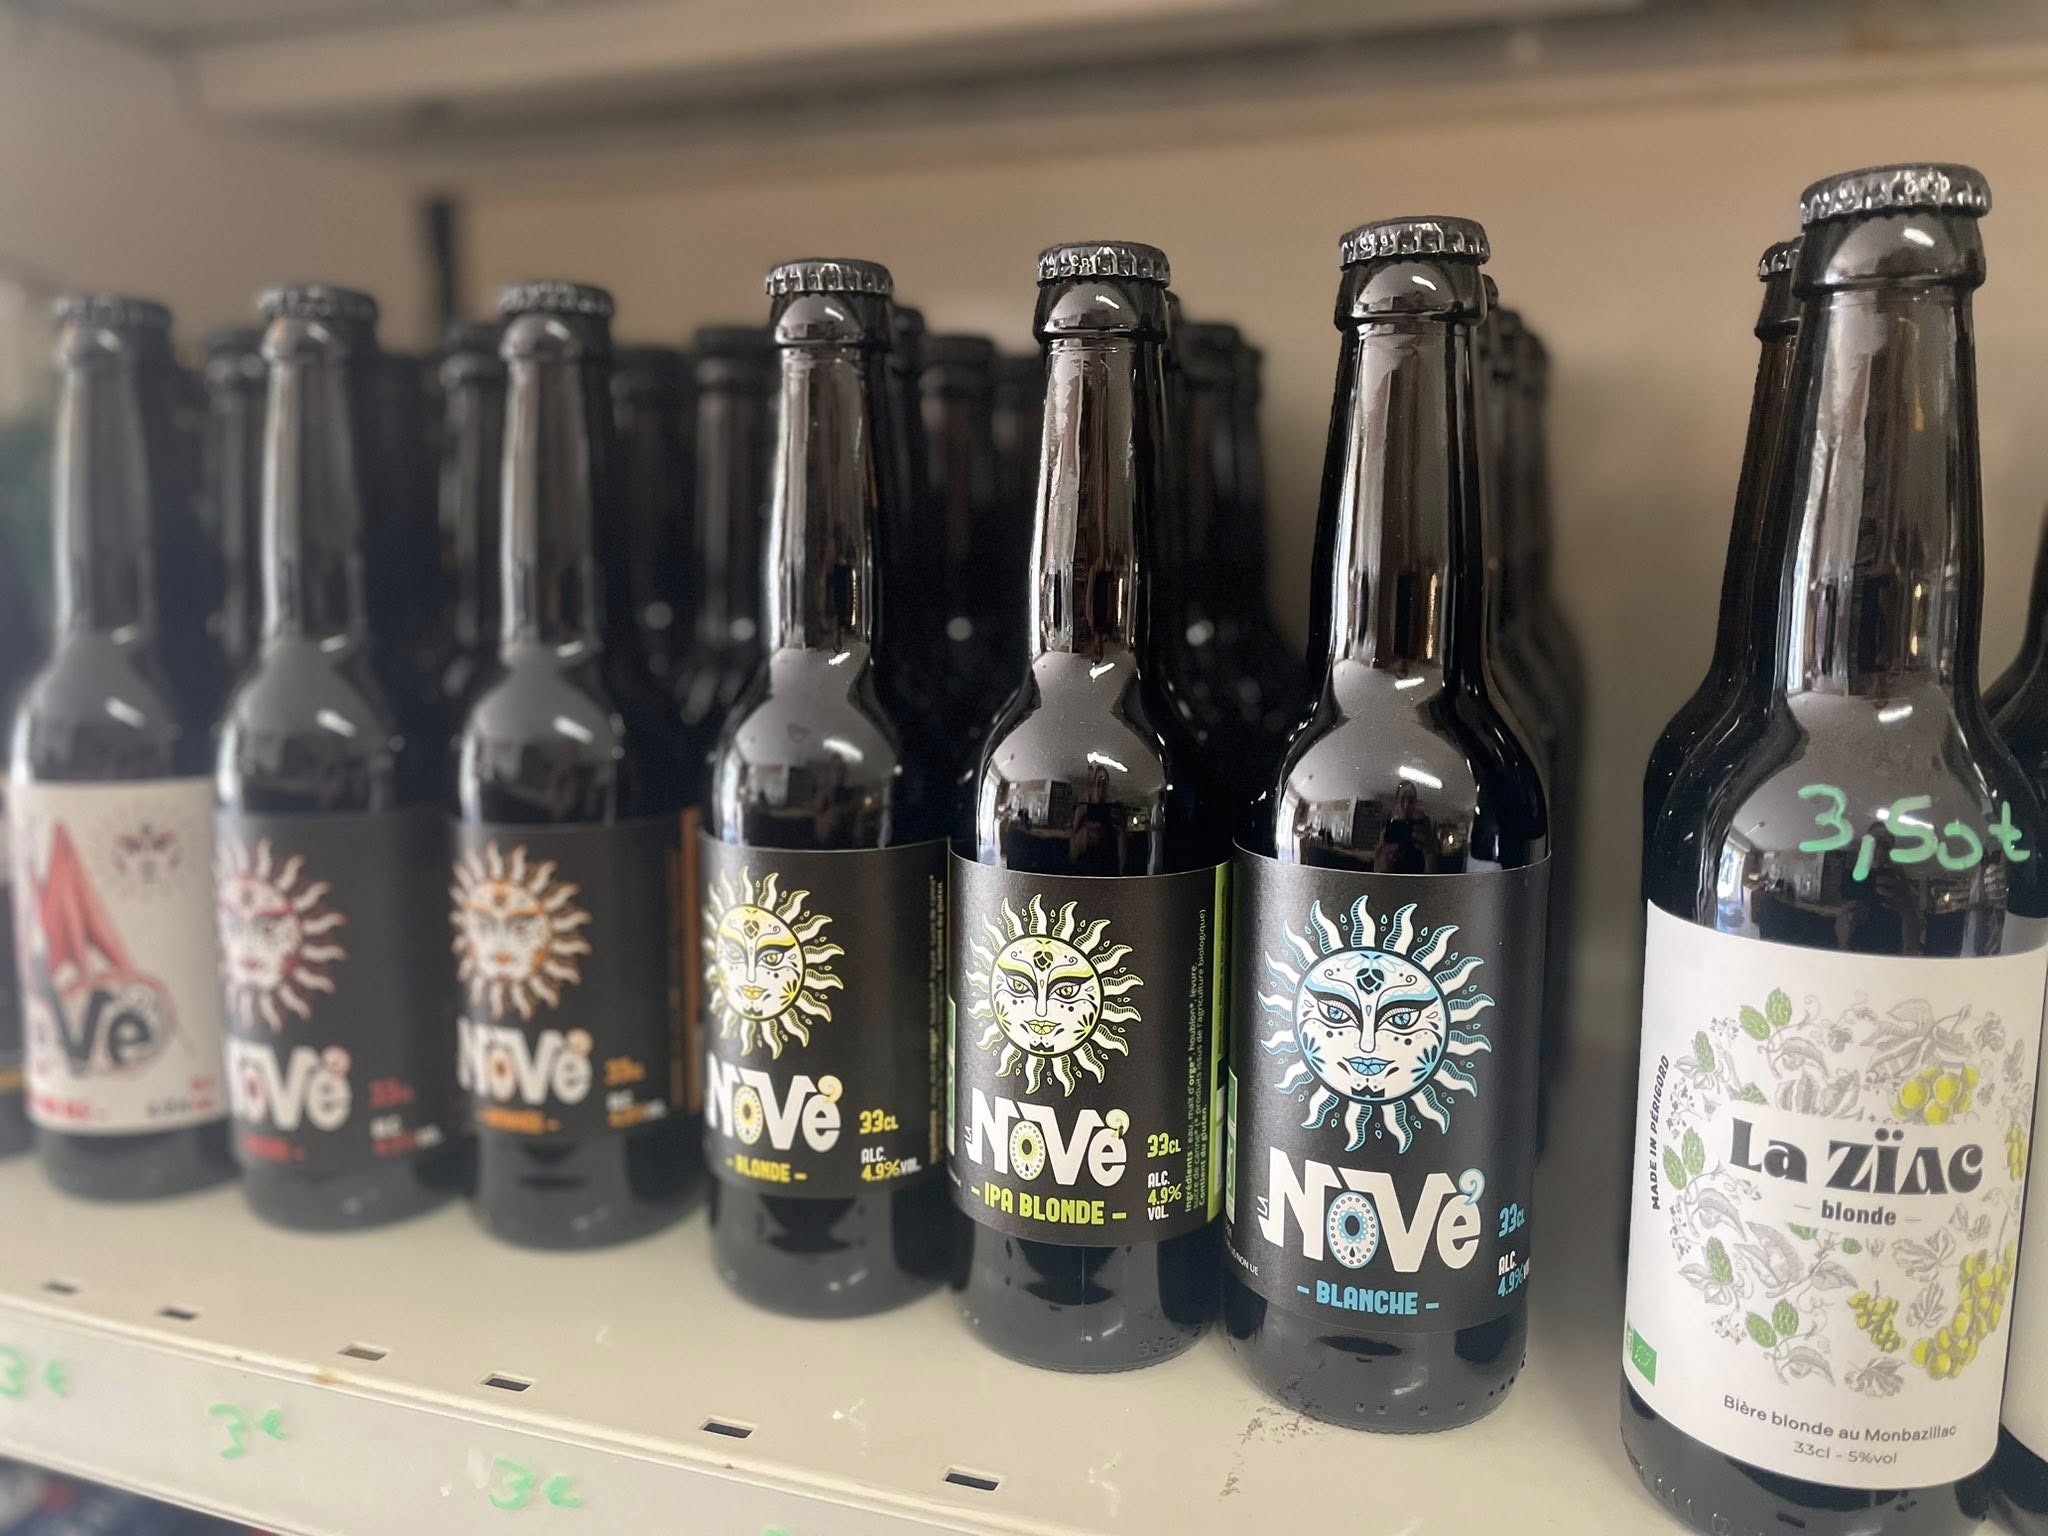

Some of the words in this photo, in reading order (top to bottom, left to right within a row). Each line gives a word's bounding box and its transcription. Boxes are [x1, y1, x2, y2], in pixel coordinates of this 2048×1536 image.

[1649, 1054, 1670, 1135] PÉRIGORD
[861, 1146, 887, 1165] ALC.
[1649, 1136, 1658, 1158] IN
[1729, 1117, 1809, 1185] La
[735, 1153, 791, 1183] BLONDE
[1147, 1170, 1171, 1189] ALC.
[1147, 1183, 1183, 1206] 4.9%
[1649, 1161, 1661, 1210] MADE
[984, 1180, 1014, 1210] IPA
[1019, 1190, 1105, 1225] BLONDE
[1147, 1205, 1170, 1221] VOL.
[1821, 1199, 1897, 1226] blonde
[1498, 1250, 1517, 1276] ALC.
[1315, 1279, 1419, 1316] BLANCHE
[1723, 1394, 1767, 1422] Bière
[1771, 1410, 1834, 1438] blonde
[1838, 1427, 1861, 1441] au
[1864, 1424, 1958, 1443] Monbazillac
[1793, 1440, 1830, 1459] 33cl
[1847, 1449, 1898, 1465] 5%vol
